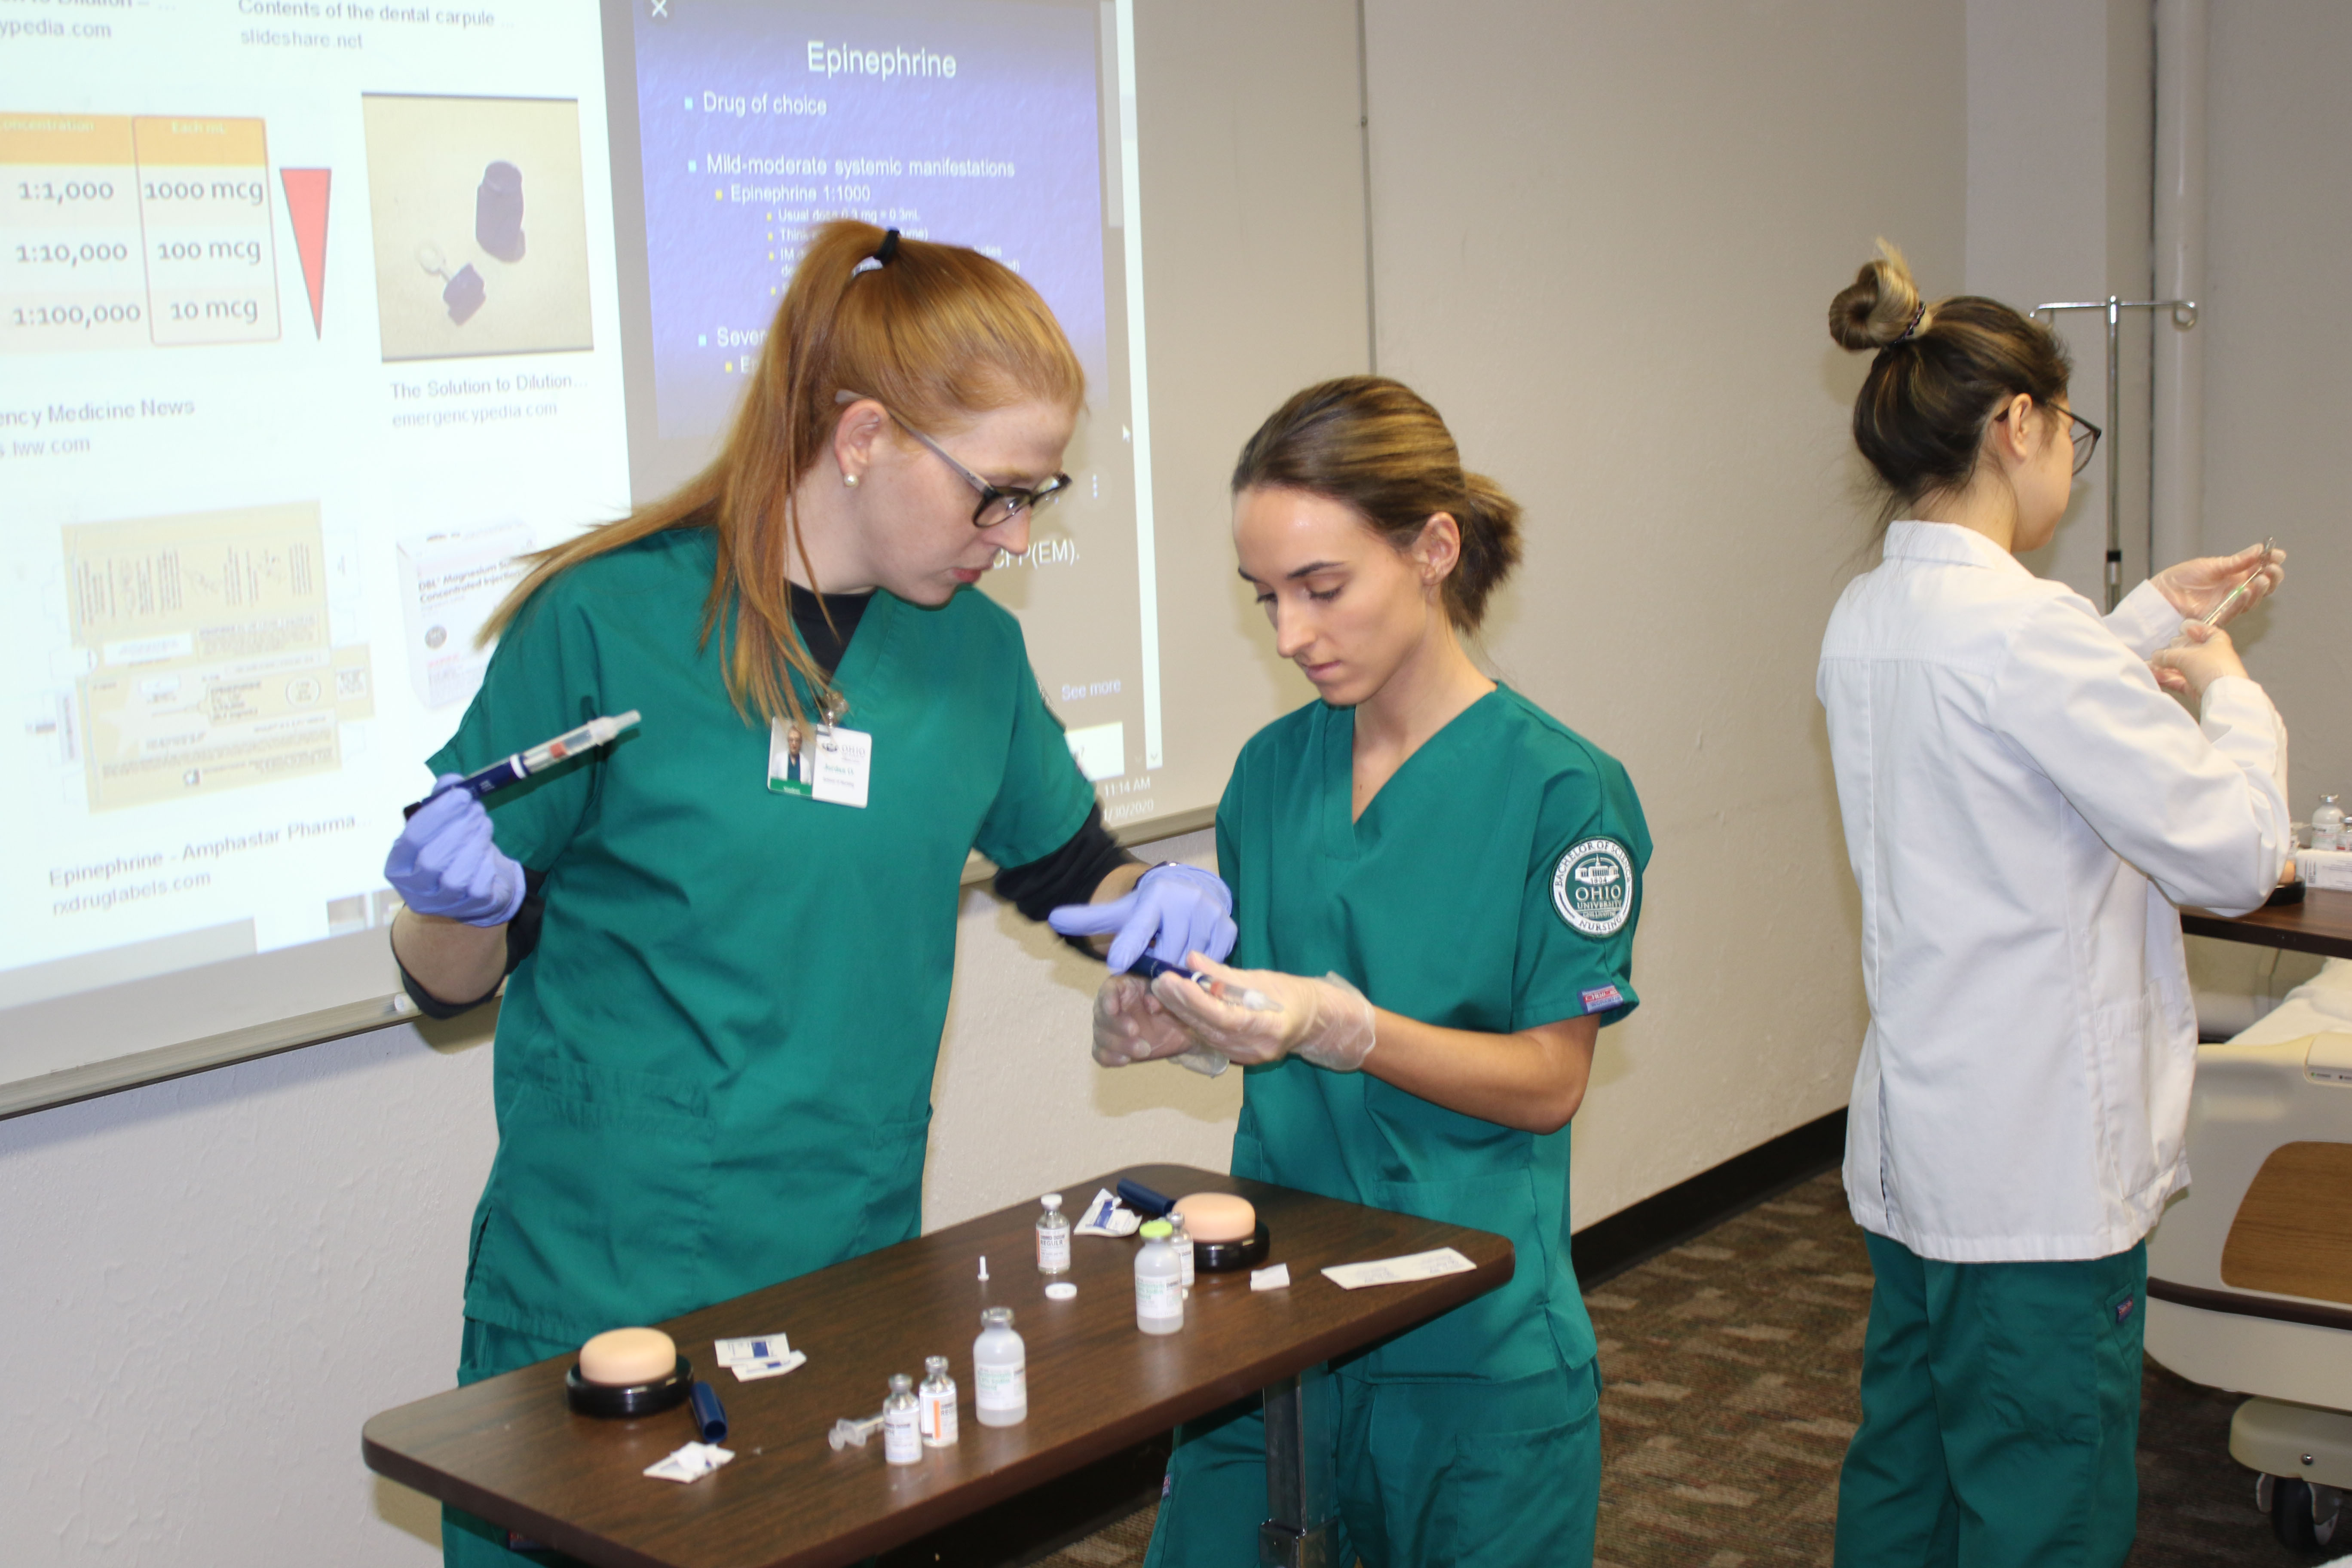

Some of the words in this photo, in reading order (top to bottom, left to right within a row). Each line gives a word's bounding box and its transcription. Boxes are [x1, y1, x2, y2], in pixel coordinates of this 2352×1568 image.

[239, 0, 321, 18] Contents
[325, 1, 343, 19] of
[347, 3, 375, 21] the
[380, 6, 430, 24] dental
[435, 9, 495, 30] carpule
[240, 27, 364, 50] slideshare.net
[807, 40, 957, 81] Epinephrine
[703, 90, 746, 118] Drug
[751, 92, 768, 113] of
[773, 93, 827, 116] choice
[707, 153, 827, 176] Mild-moderate
[835, 154, 902, 179] systemic
[909, 156, 1015, 178] manifestations
[18, 181, 114, 205] 1:1,000
[145, 181, 205, 201] 1000
[211, 182, 264, 205] mcg
[731, 183, 817, 205] Epinephrine
[823, 184, 871, 202] 1:1000
[778, 207, 809, 223] Usual
[861, 209, 877, 224] mg
[16, 242, 128, 268] 1:10,000
[157, 241, 202, 260] 100
[208, 239, 262, 266] mcg
[12, 303, 141, 329] 1:100,000
[170, 302, 199, 320] 10
[205, 299, 259, 325] mcg
[389, 380, 423, 401] The
[427, 377, 491, 398] Solution
[496, 376, 511, 394] to
[48, 400, 135, 425] Medicine
[140, 397, 196, 417] News
[391, 401, 559, 429] emergencypedia.com
[1061, 683, 1087, 702] See
[1090, 678, 1122, 698] more
[1104, 778, 1131, 799] 11:14
[1133, 774, 1151, 793] AM
[49, 851, 164, 888] Epinephrine
[181, 828, 282, 862] Amphastar
[1554, 842, 1593, 887] BACHELOR
[1596, 840, 1610, 851] OF
[1611, 844, 1632, 883] SCIENCE
[52, 869, 212, 918] rxdruglabels.com
[1590, 876, 1608, 885] 1804
[1575, 885, 1622, 903] OHIO
[1576, 900, 1623, 910] UNIVERSITY
[1579, 914, 1622, 931] NURSING
